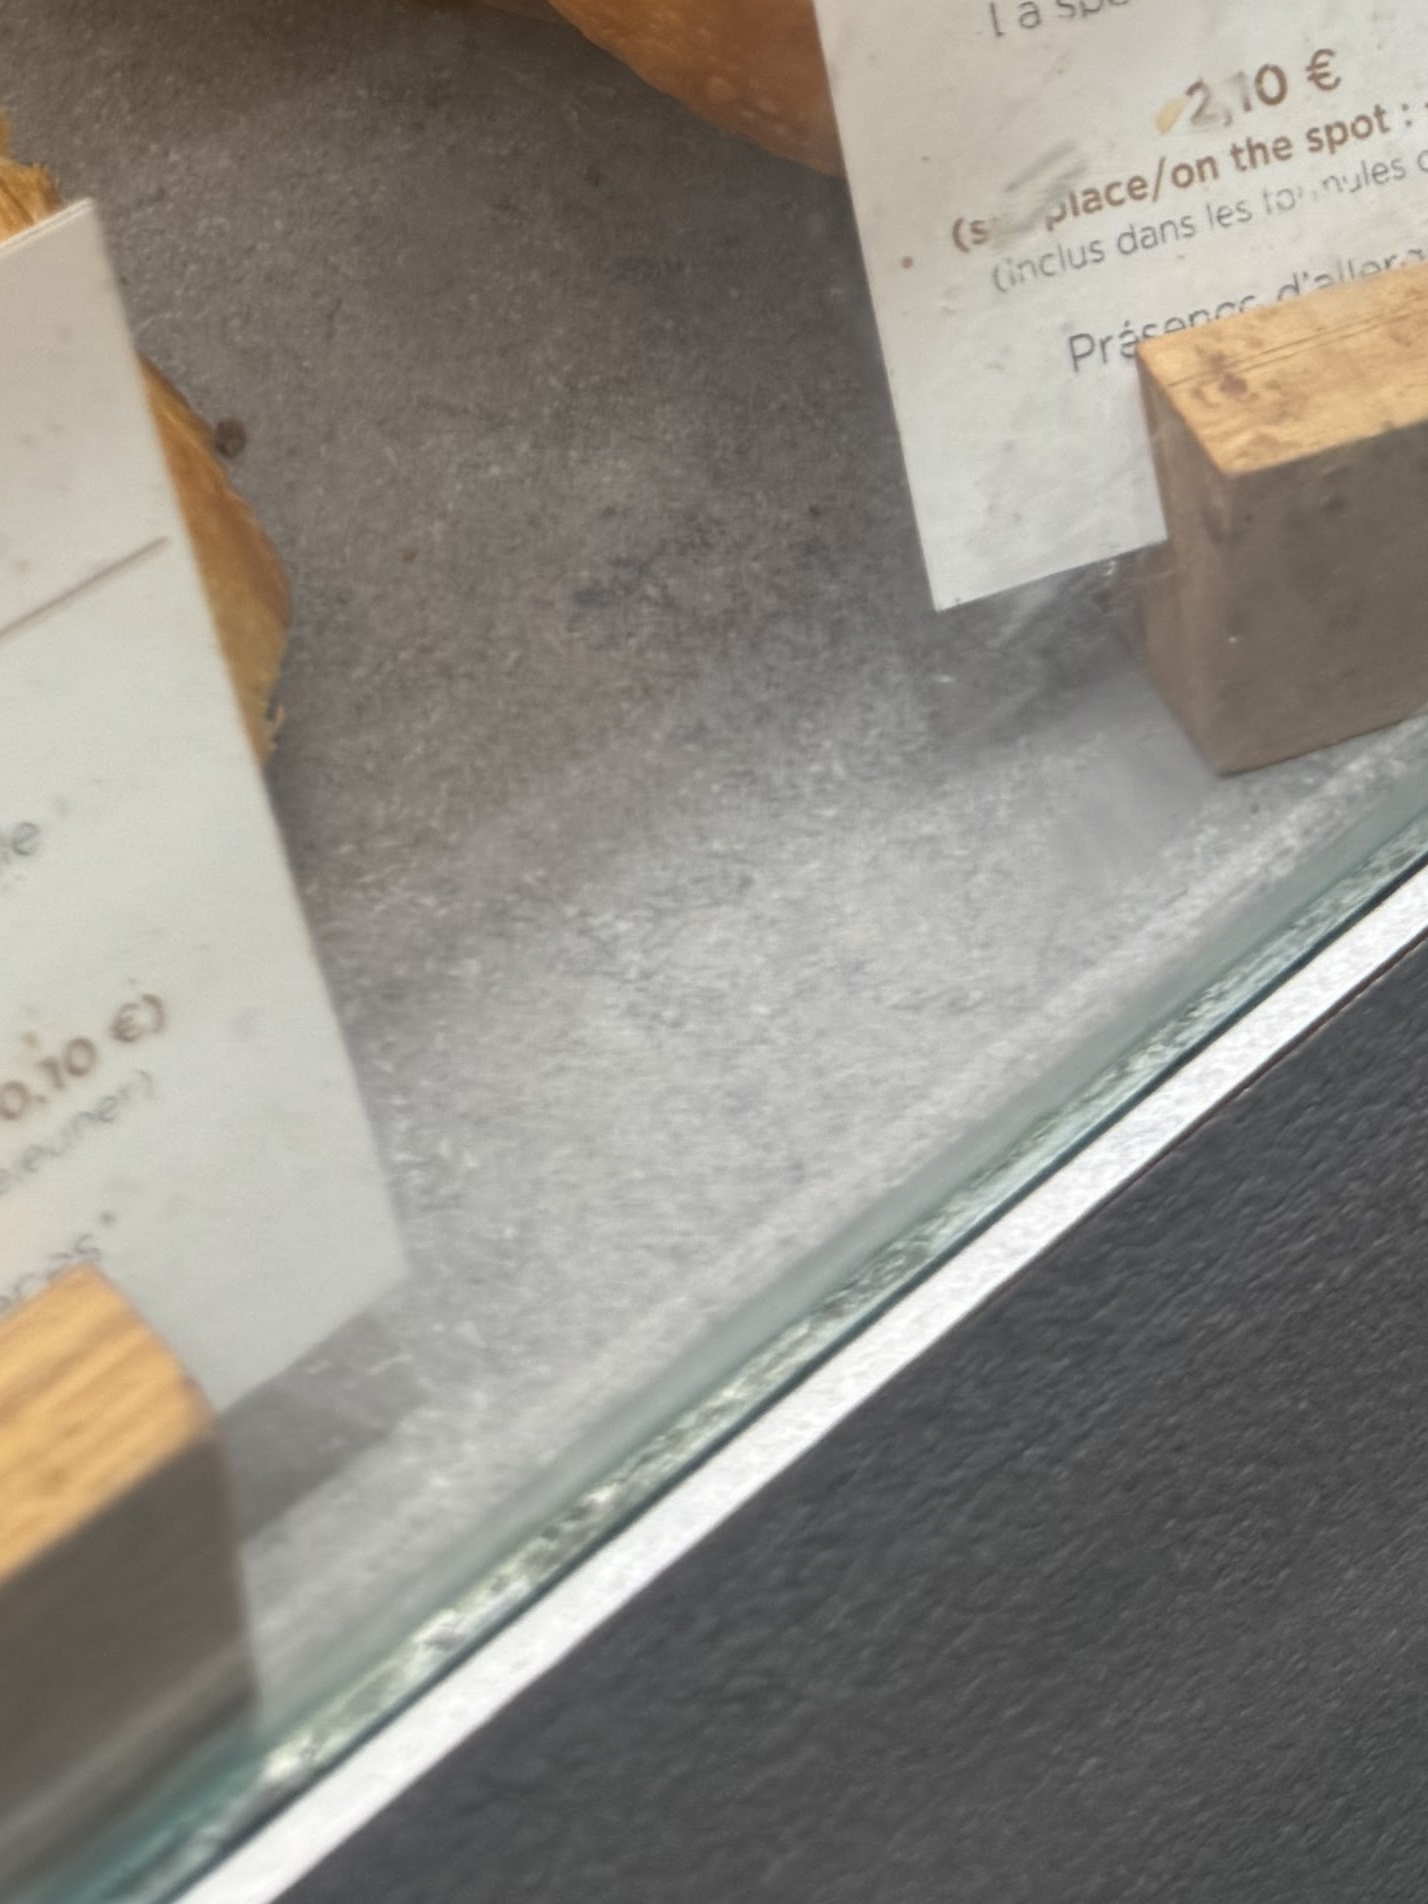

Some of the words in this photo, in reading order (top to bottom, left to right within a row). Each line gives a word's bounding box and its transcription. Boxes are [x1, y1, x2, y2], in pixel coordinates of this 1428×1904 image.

[1186, 64, 1288, 127] 2,10
[1306, 48, 1342, 92] €
[1230, 136, 1292, 172] the
[1306, 104, 1391, 155] spot
[992, 239, 1105, 293] (inclus
[1117, 214, 1196, 256] dans
[1207, 198, 1252, 230] les
